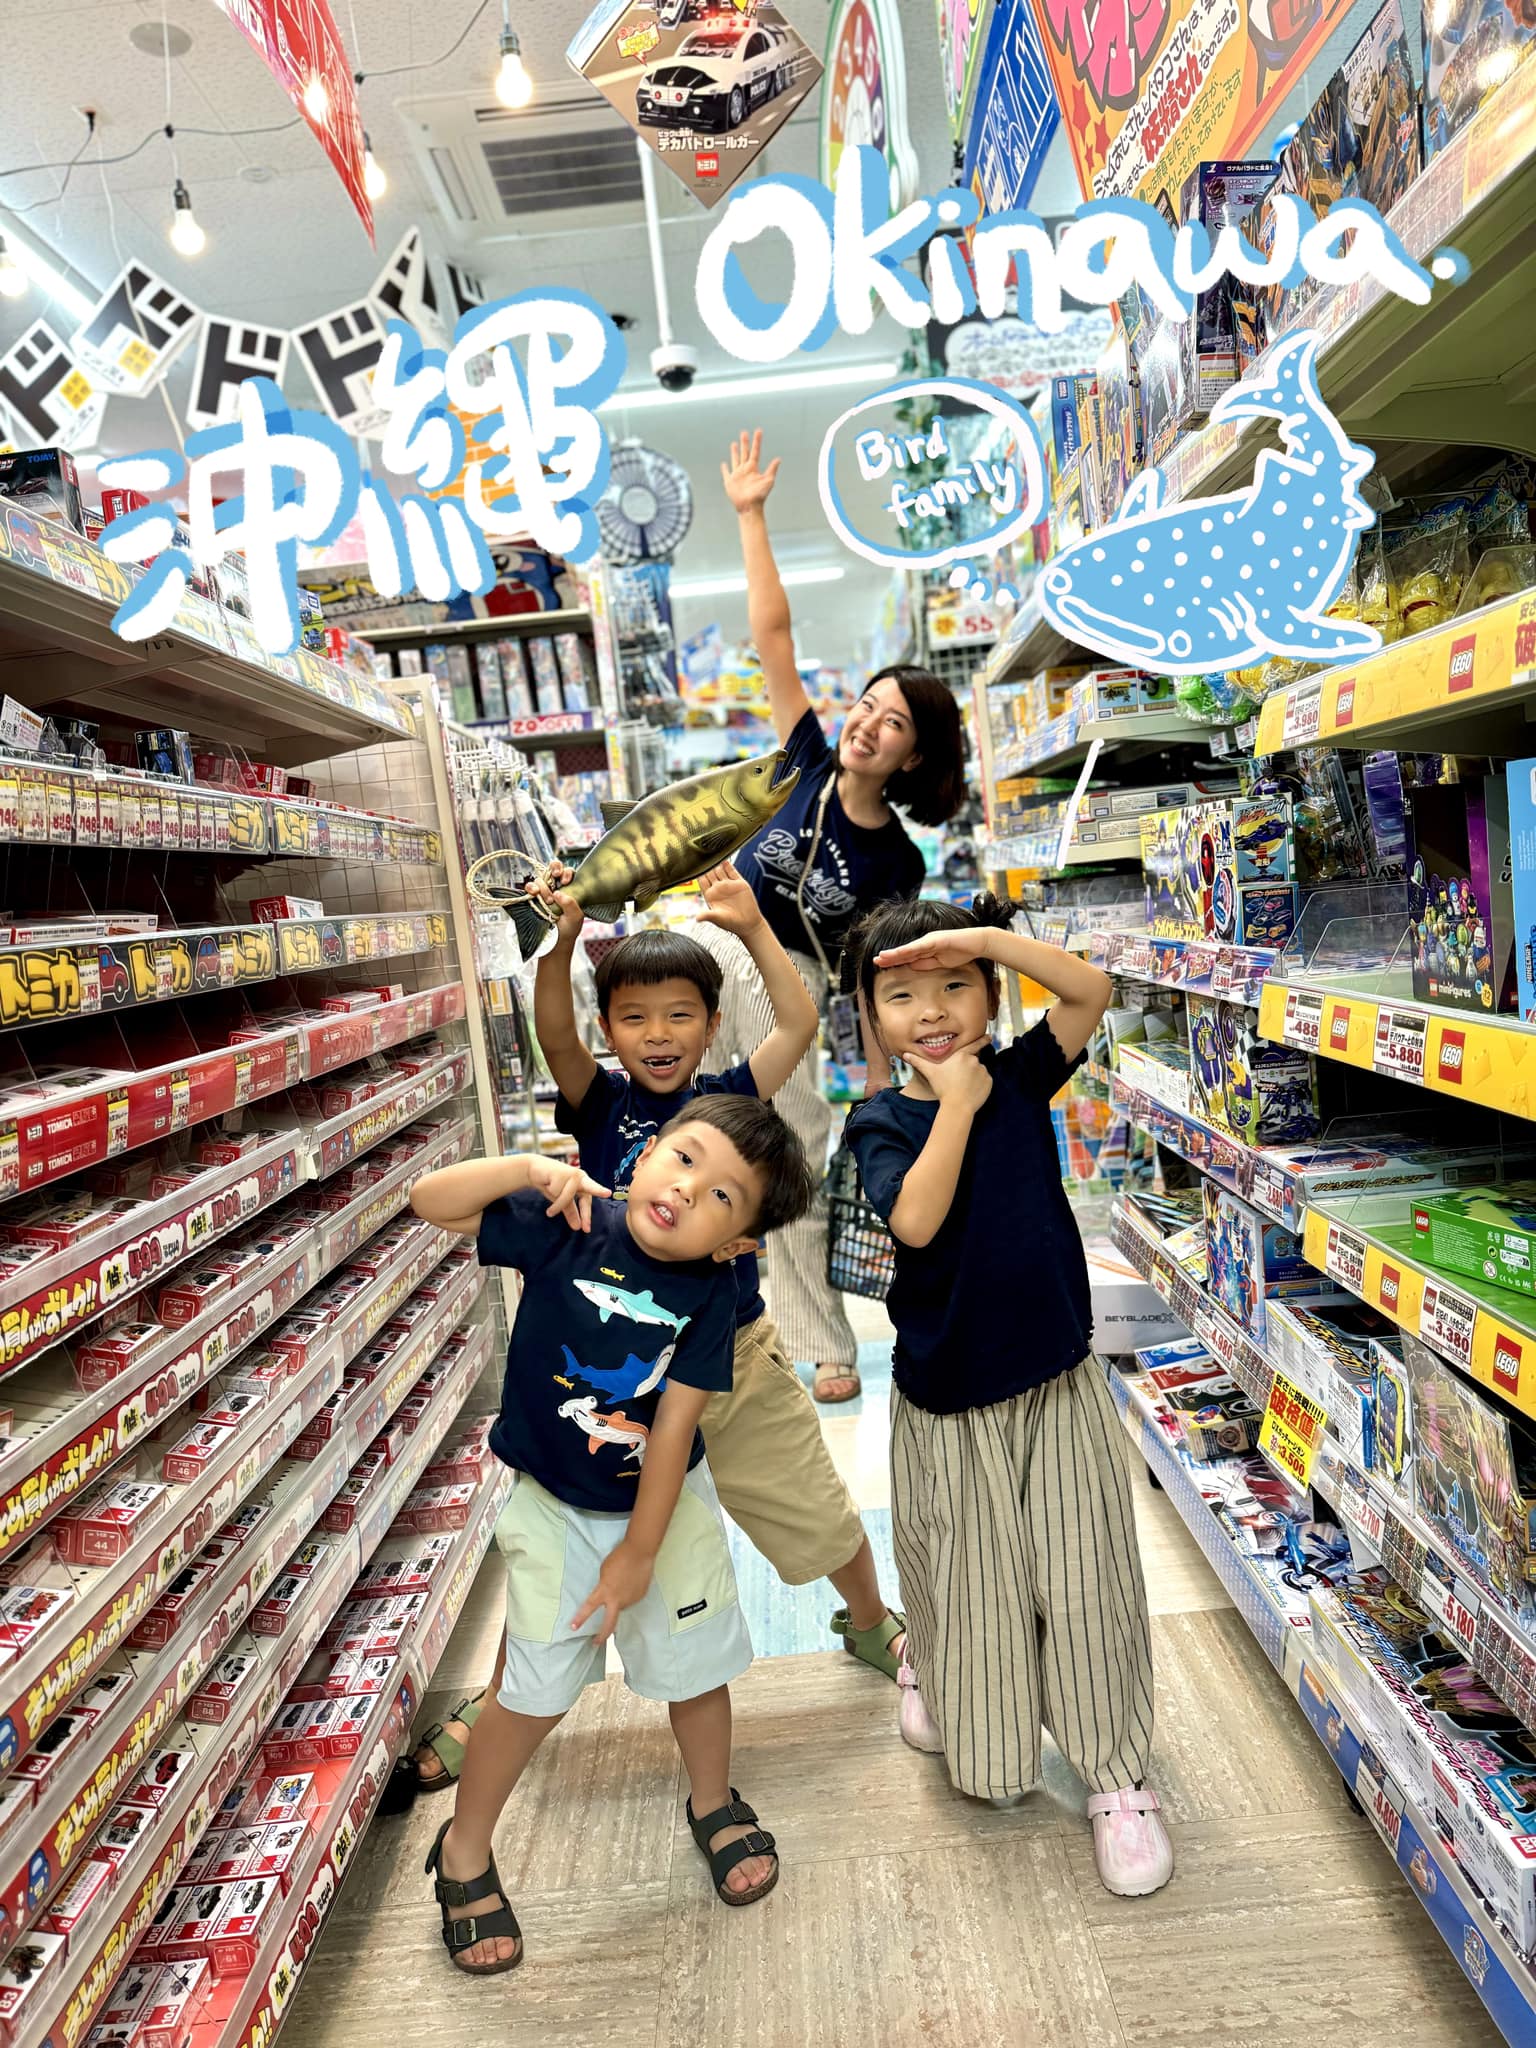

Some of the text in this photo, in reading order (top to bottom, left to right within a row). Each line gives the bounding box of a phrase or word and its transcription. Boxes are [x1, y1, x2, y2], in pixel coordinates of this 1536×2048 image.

[658, 136, 760, 151] デカパトロールカー
[696, 158, 718, 171] トミカ
[1450, 649, 1474, 677] LEGO
[1337, 690, 1353, 713] LEGO
[1294, 1020, 1319, 1038] 488
[1332, 1018, 1348, 1038] LEGO
[1388, 1043, 1423, 1066] 5,880
[1440, 1042, 1464, 1068] LEGO
[47, 1119, 73, 1136] TOMICA
[48, 1154, 73, 1171] TOMICA
[1415, 1215, 1429, 1227] LEGO
[1336, 1256, 1363, 1282] 1,380
[1381, 1276, 1398, 1297] LEGO
[1211, 1328, 1233, 1361] 4,980
[1434, 1319, 1471, 1354] 3,380
[1496, 1349, 1519, 1378] LEGO
[1269, 1383, 1316, 1440] 破格値
[177, 1467, 190, 1476] 46
[1278, 1445, 1305, 1477] 3,500
[1361, 1503, 1380, 1539] 2,780
[94, 1540, 109, 1550] 44
[1447, 1595, 1475, 1643] 5,180
[143, 1626, 157, 1636] 67
[23, 1572, 156, 1741] まとめ買いがおトク!!
[27, 1757, 47, 1774] 64
[192, 1920, 210, 1939] 105
[239, 1917, 257, 1932] 61
[225, 1955, 238, 1963] 61
[160, 2004, 179, 2025] 104
